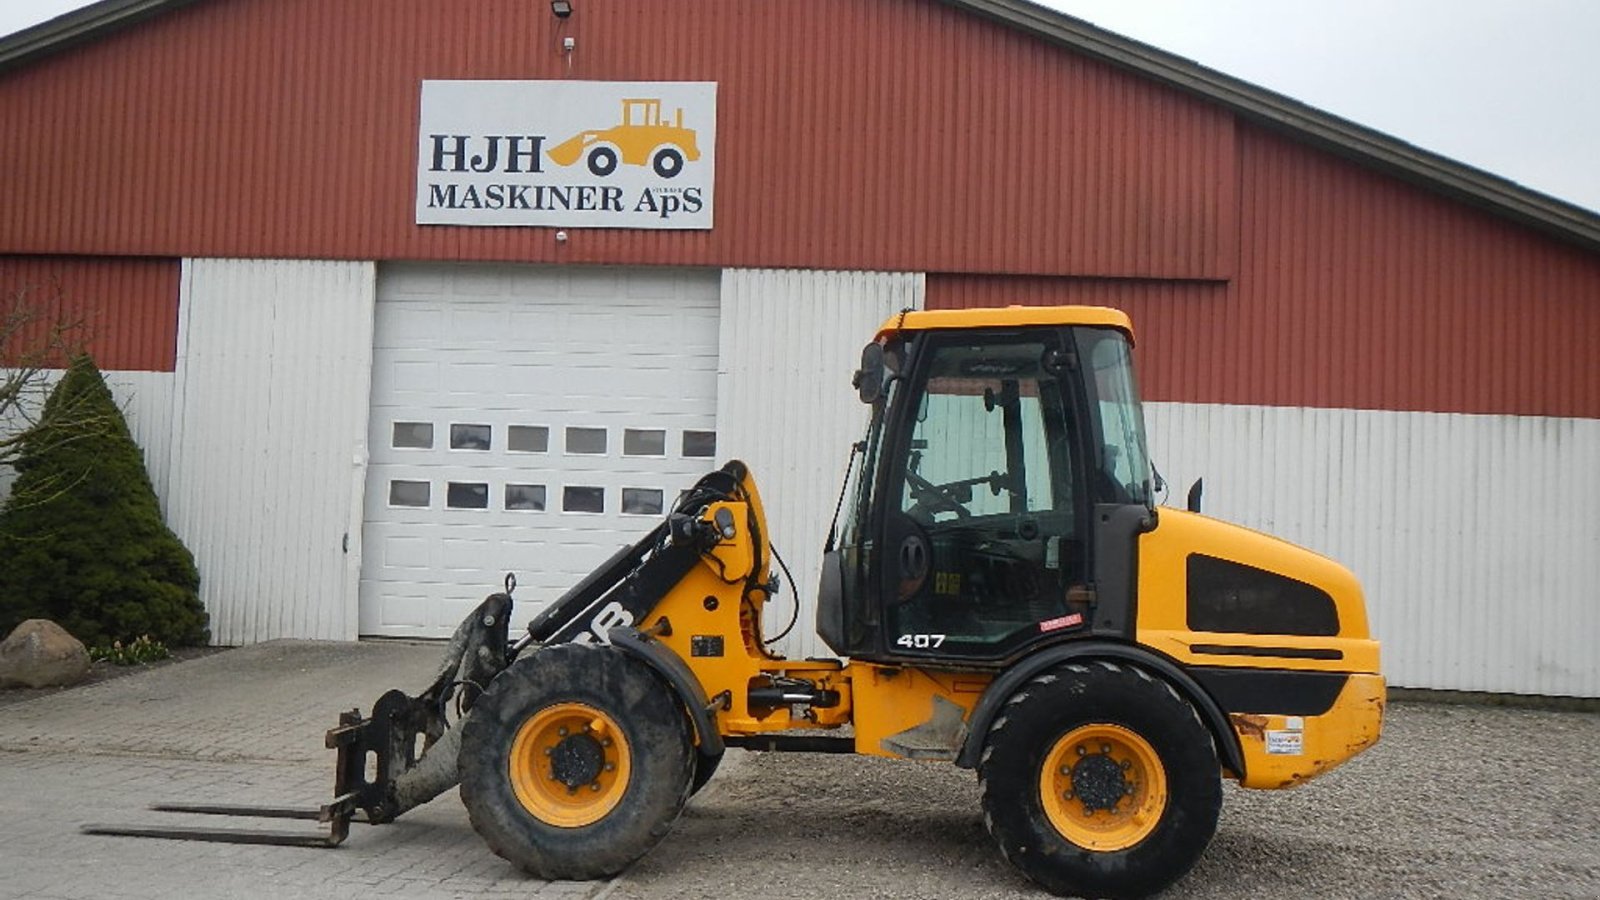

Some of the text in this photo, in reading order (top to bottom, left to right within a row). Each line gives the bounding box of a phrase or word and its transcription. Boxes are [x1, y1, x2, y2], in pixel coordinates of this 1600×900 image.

[428, 135, 546, 173] HJH
[427, 184, 702, 218] MASKINER ApS
[897, 634, 946, 648] 407
